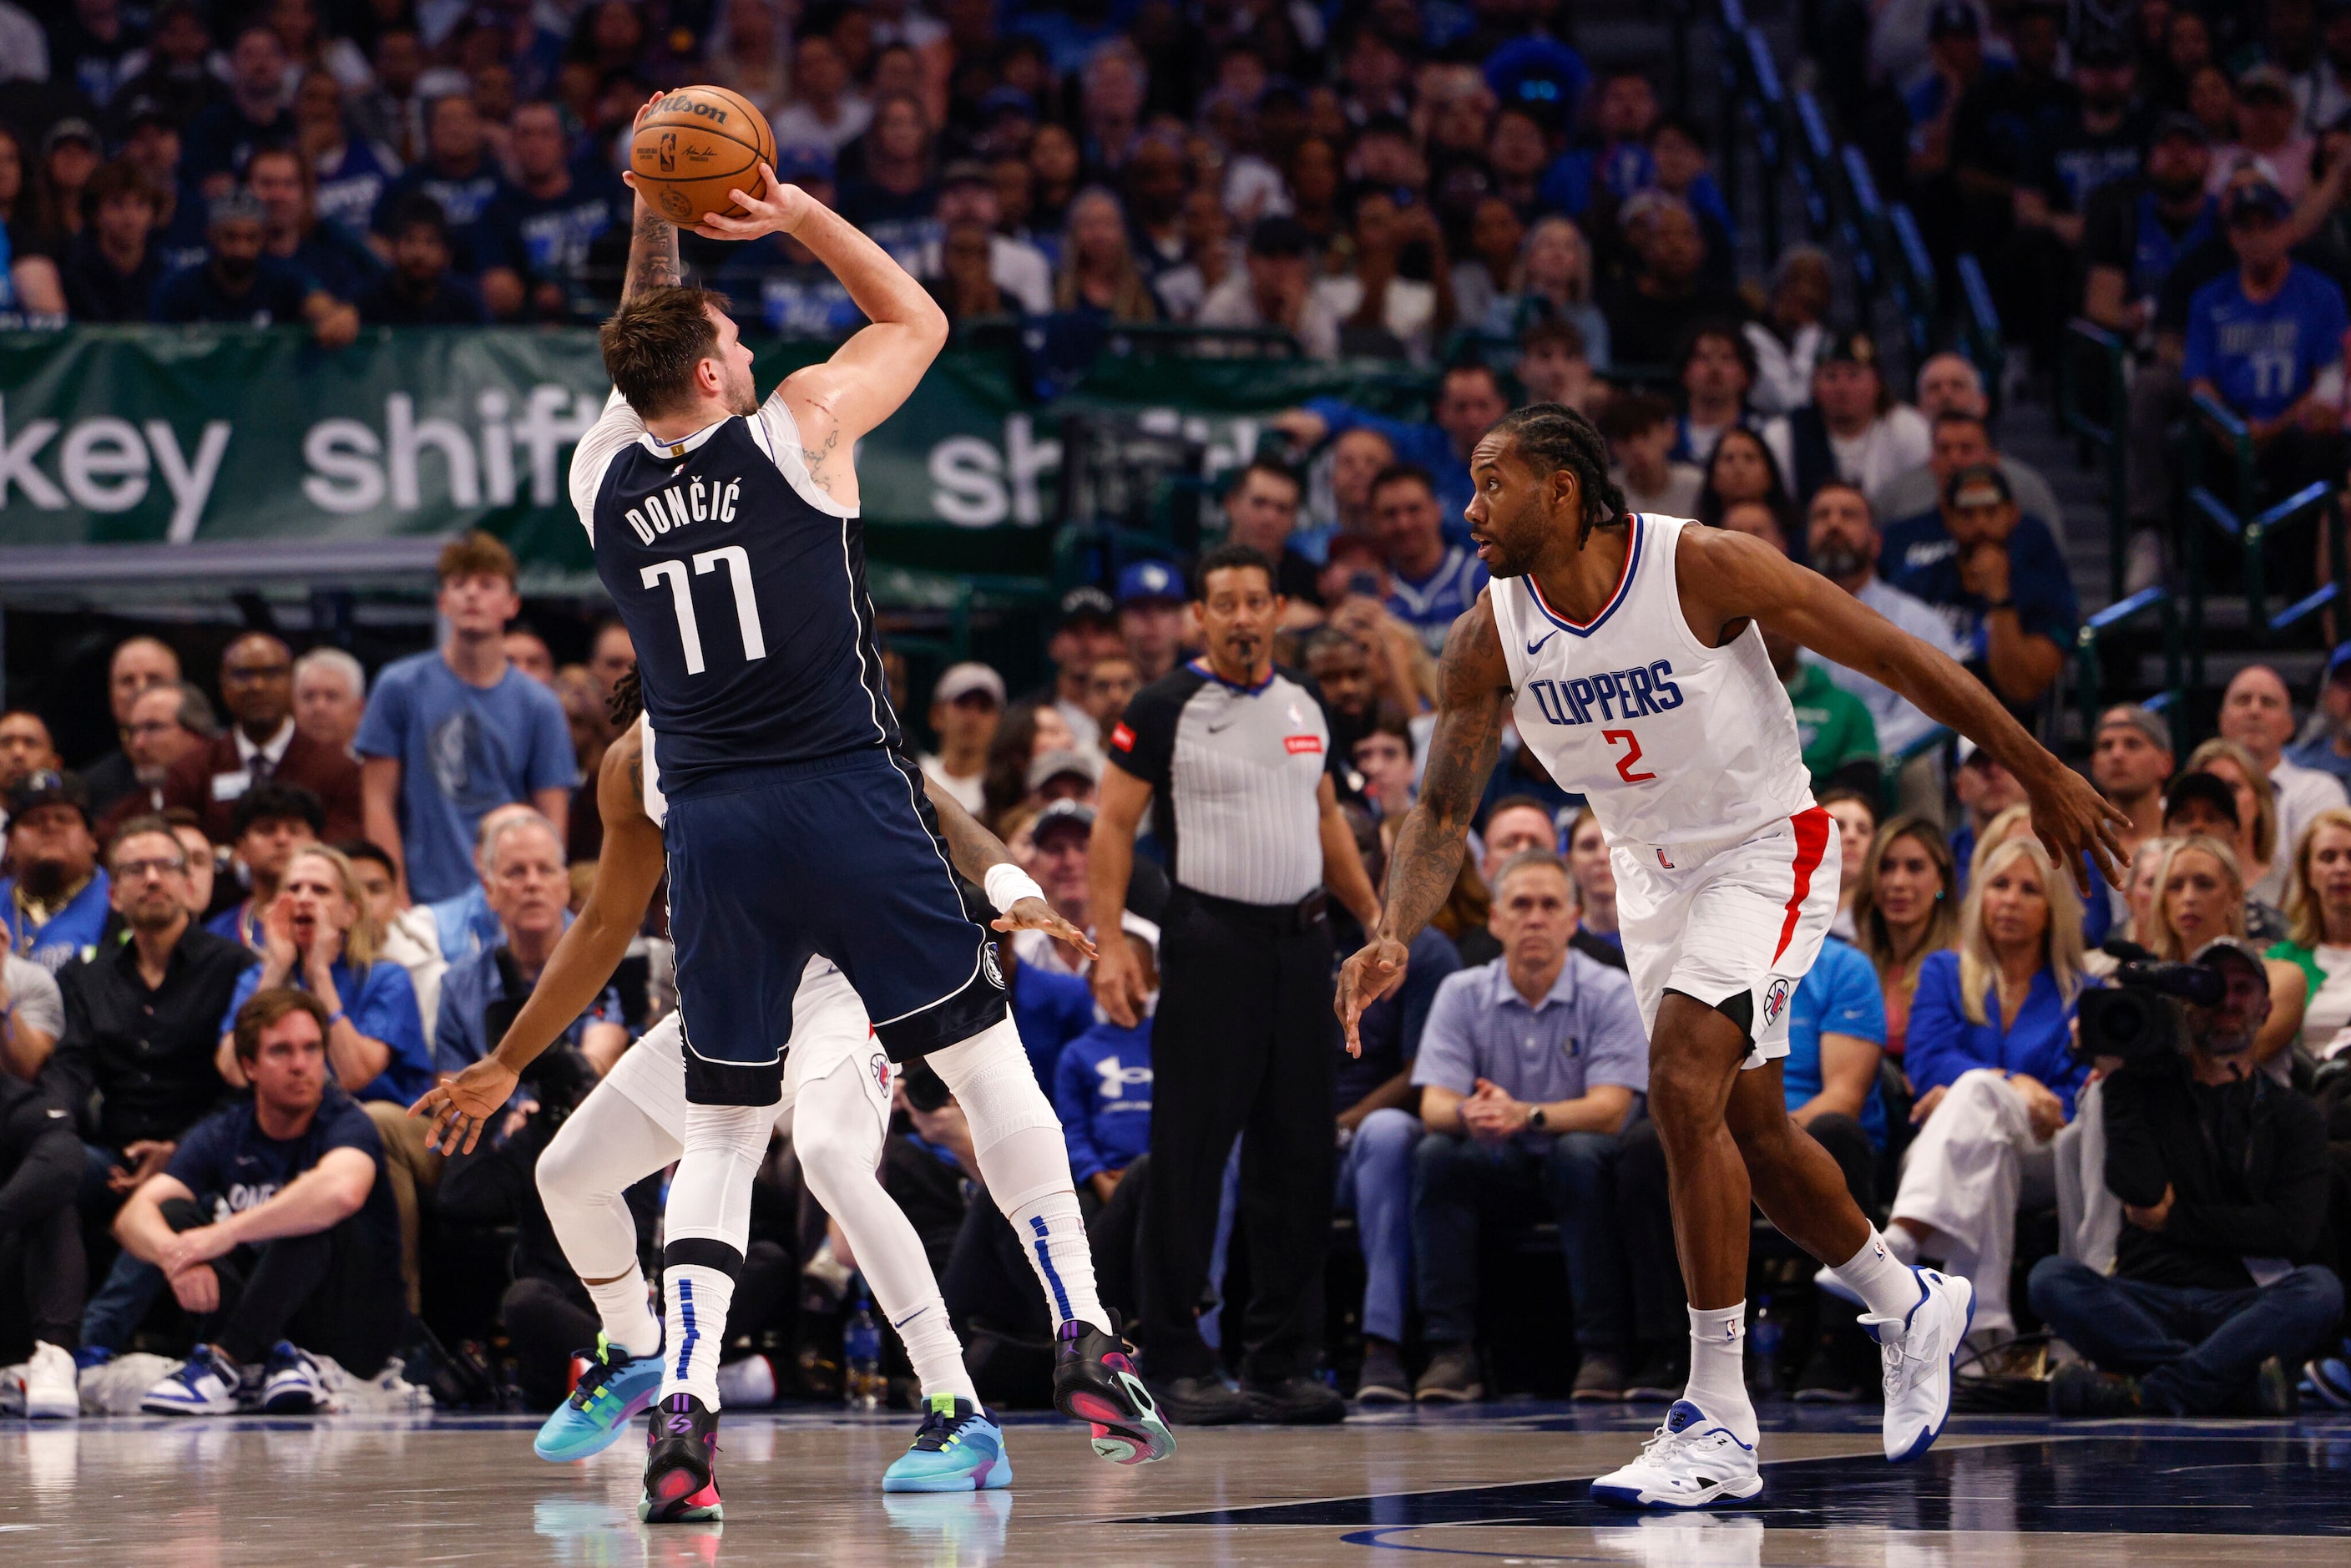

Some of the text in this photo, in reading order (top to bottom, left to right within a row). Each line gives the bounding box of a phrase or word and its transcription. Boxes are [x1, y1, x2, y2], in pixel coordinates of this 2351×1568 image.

[0, 391, 231, 544] key
[624, 475, 741, 546] DONČIĆ
[640, 545, 766, 675] 77
[1528, 659, 1684, 725] CLIPPERS
[1601, 729, 1656, 782] 2
